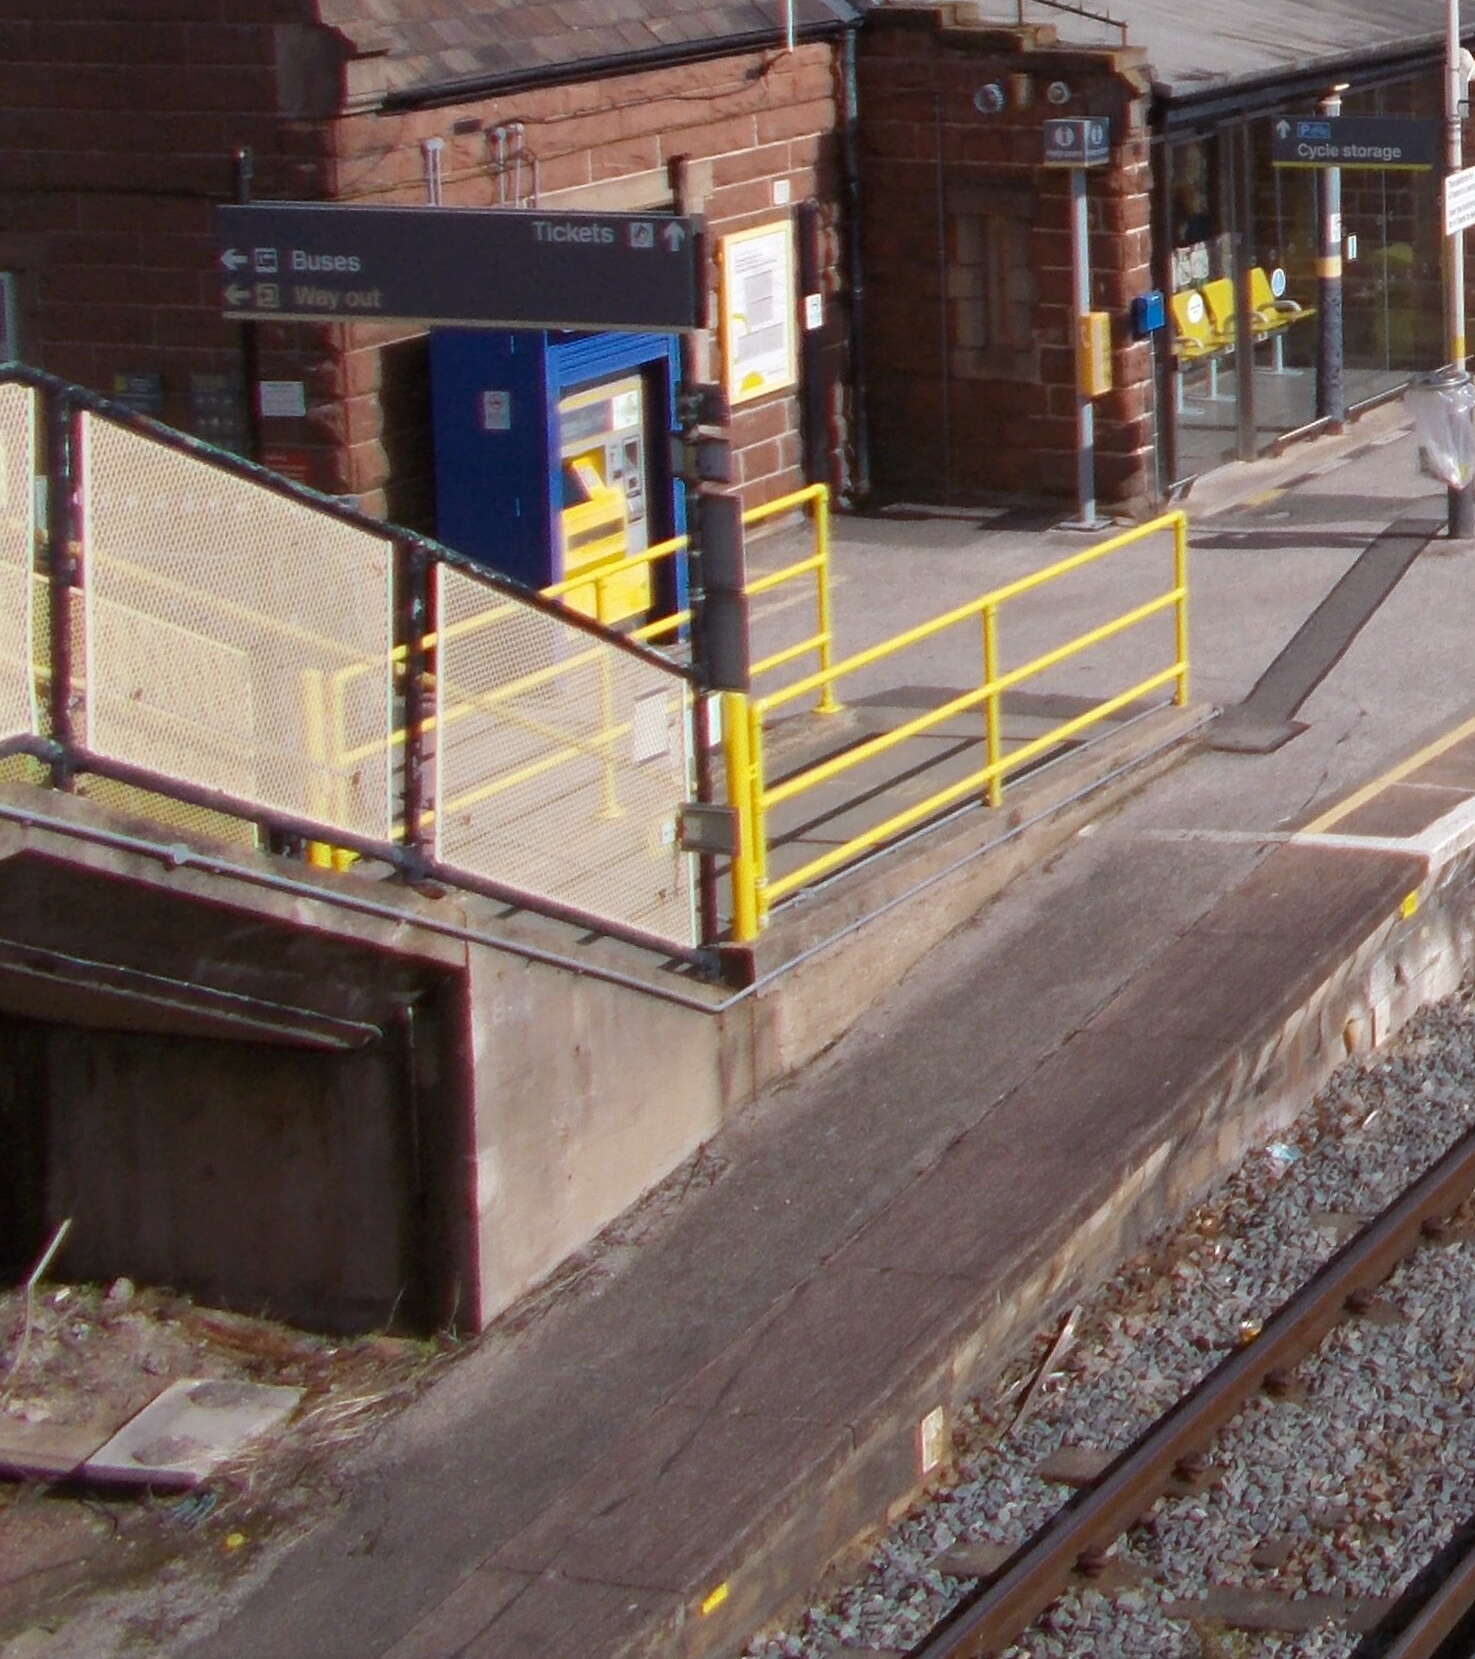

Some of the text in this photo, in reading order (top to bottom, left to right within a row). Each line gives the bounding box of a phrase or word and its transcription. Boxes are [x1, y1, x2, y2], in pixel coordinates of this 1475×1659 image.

[1297, 143, 1402, 162] Cycle storage
[532, 220, 615, 245] Tickets
[292, 249, 362, 272] Buses
[293, 286, 382, 310] Way out
